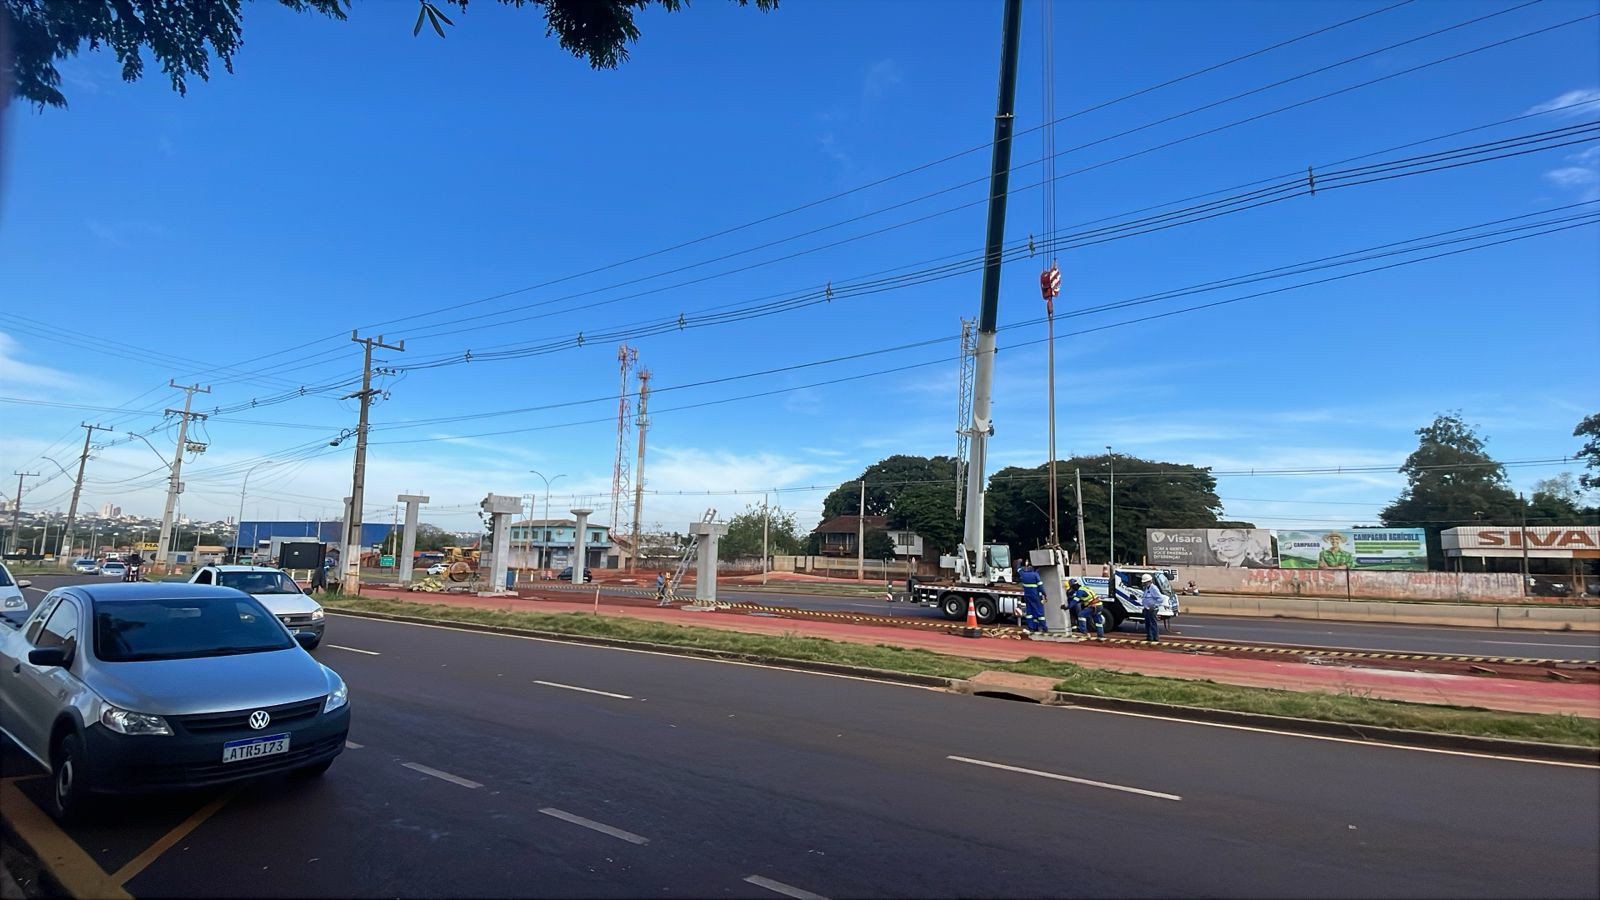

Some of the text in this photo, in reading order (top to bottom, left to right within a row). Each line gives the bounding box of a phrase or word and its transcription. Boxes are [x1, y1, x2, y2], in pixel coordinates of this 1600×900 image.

[1167, 534, 1202, 543] Visara
[1389, 532, 1419, 541] AGRÍCOLA
[1478, 531, 1600, 546] SIVA
